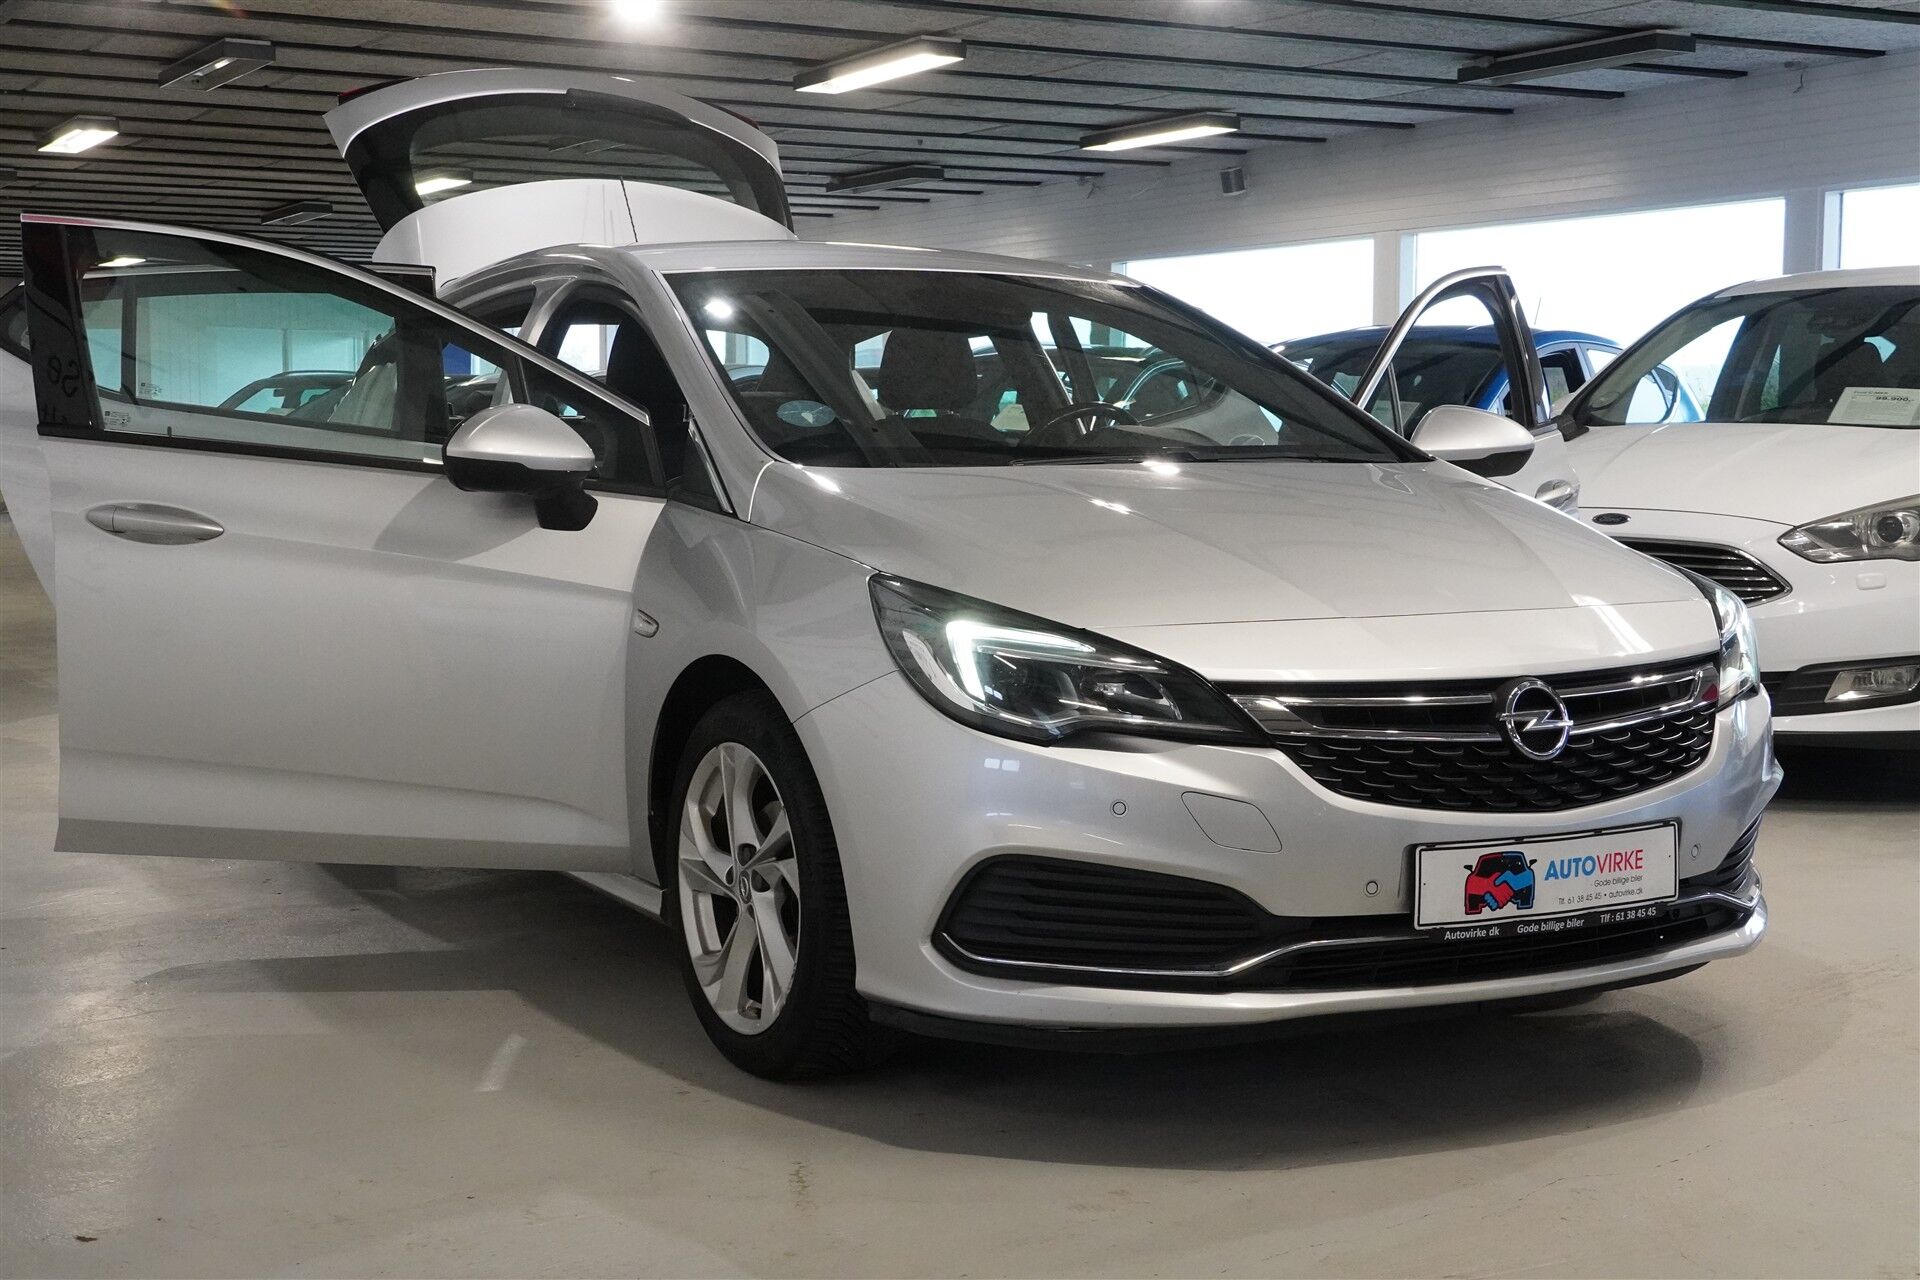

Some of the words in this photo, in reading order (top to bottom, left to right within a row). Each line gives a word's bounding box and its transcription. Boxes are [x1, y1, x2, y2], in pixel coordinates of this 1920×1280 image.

[1544, 849, 1644, 881] AUTOVIRKE
[1594, 878, 1611, 887] Gode
[1612, 876, 1629, 885] billige
[1630, 874, 1643, 883] biler
[1567, 896, 1574, 905] 61
[1576, 895, 1584, 903] 38
[1586, 893, 1593, 901] 45
[1594, 892, 1602, 900] 45
[1609, 887, 1643, 898] autovirke.dk
[1444, 928, 1487, 940] Autovirke
[1489, 926, 1500, 936] dk
[1517, 923, 1539, 933] Gode
[1541, 920, 1565, 932] billige
[1566, 918, 1585, 928] biler
[1615, 912, 1625, 921] 61
[1626, 910, 1636, 919] 38
[1636, 908, 1646, 917] 45
[1647, 906, 1657, 916] 45
